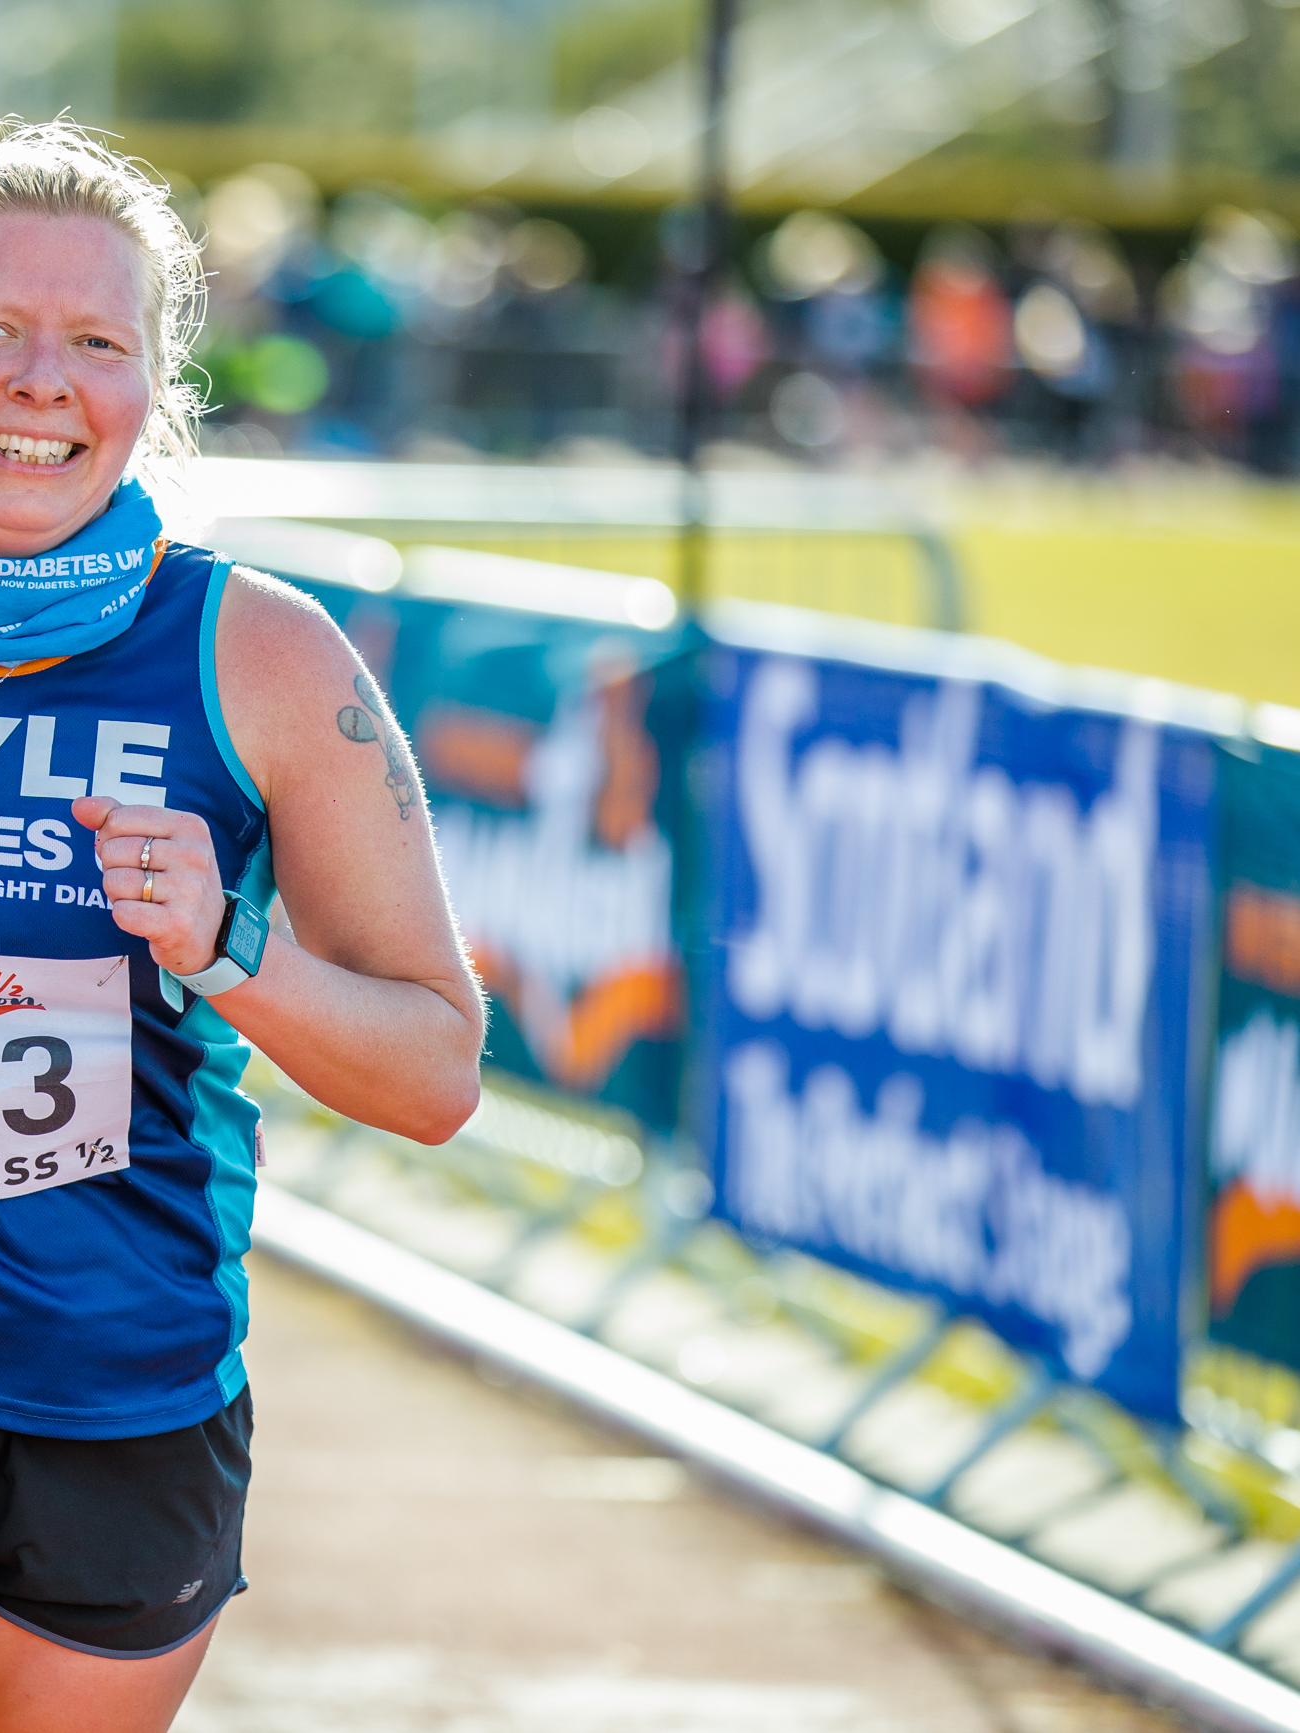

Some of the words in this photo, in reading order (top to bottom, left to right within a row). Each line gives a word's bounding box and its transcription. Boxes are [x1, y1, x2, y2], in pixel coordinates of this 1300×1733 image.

[115, 547, 145, 571] UK
[27, 579, 79, 590] DIABETES.
[81, 577, 107, 588] FIGHT
[54, 884, 113, 911] DIA
